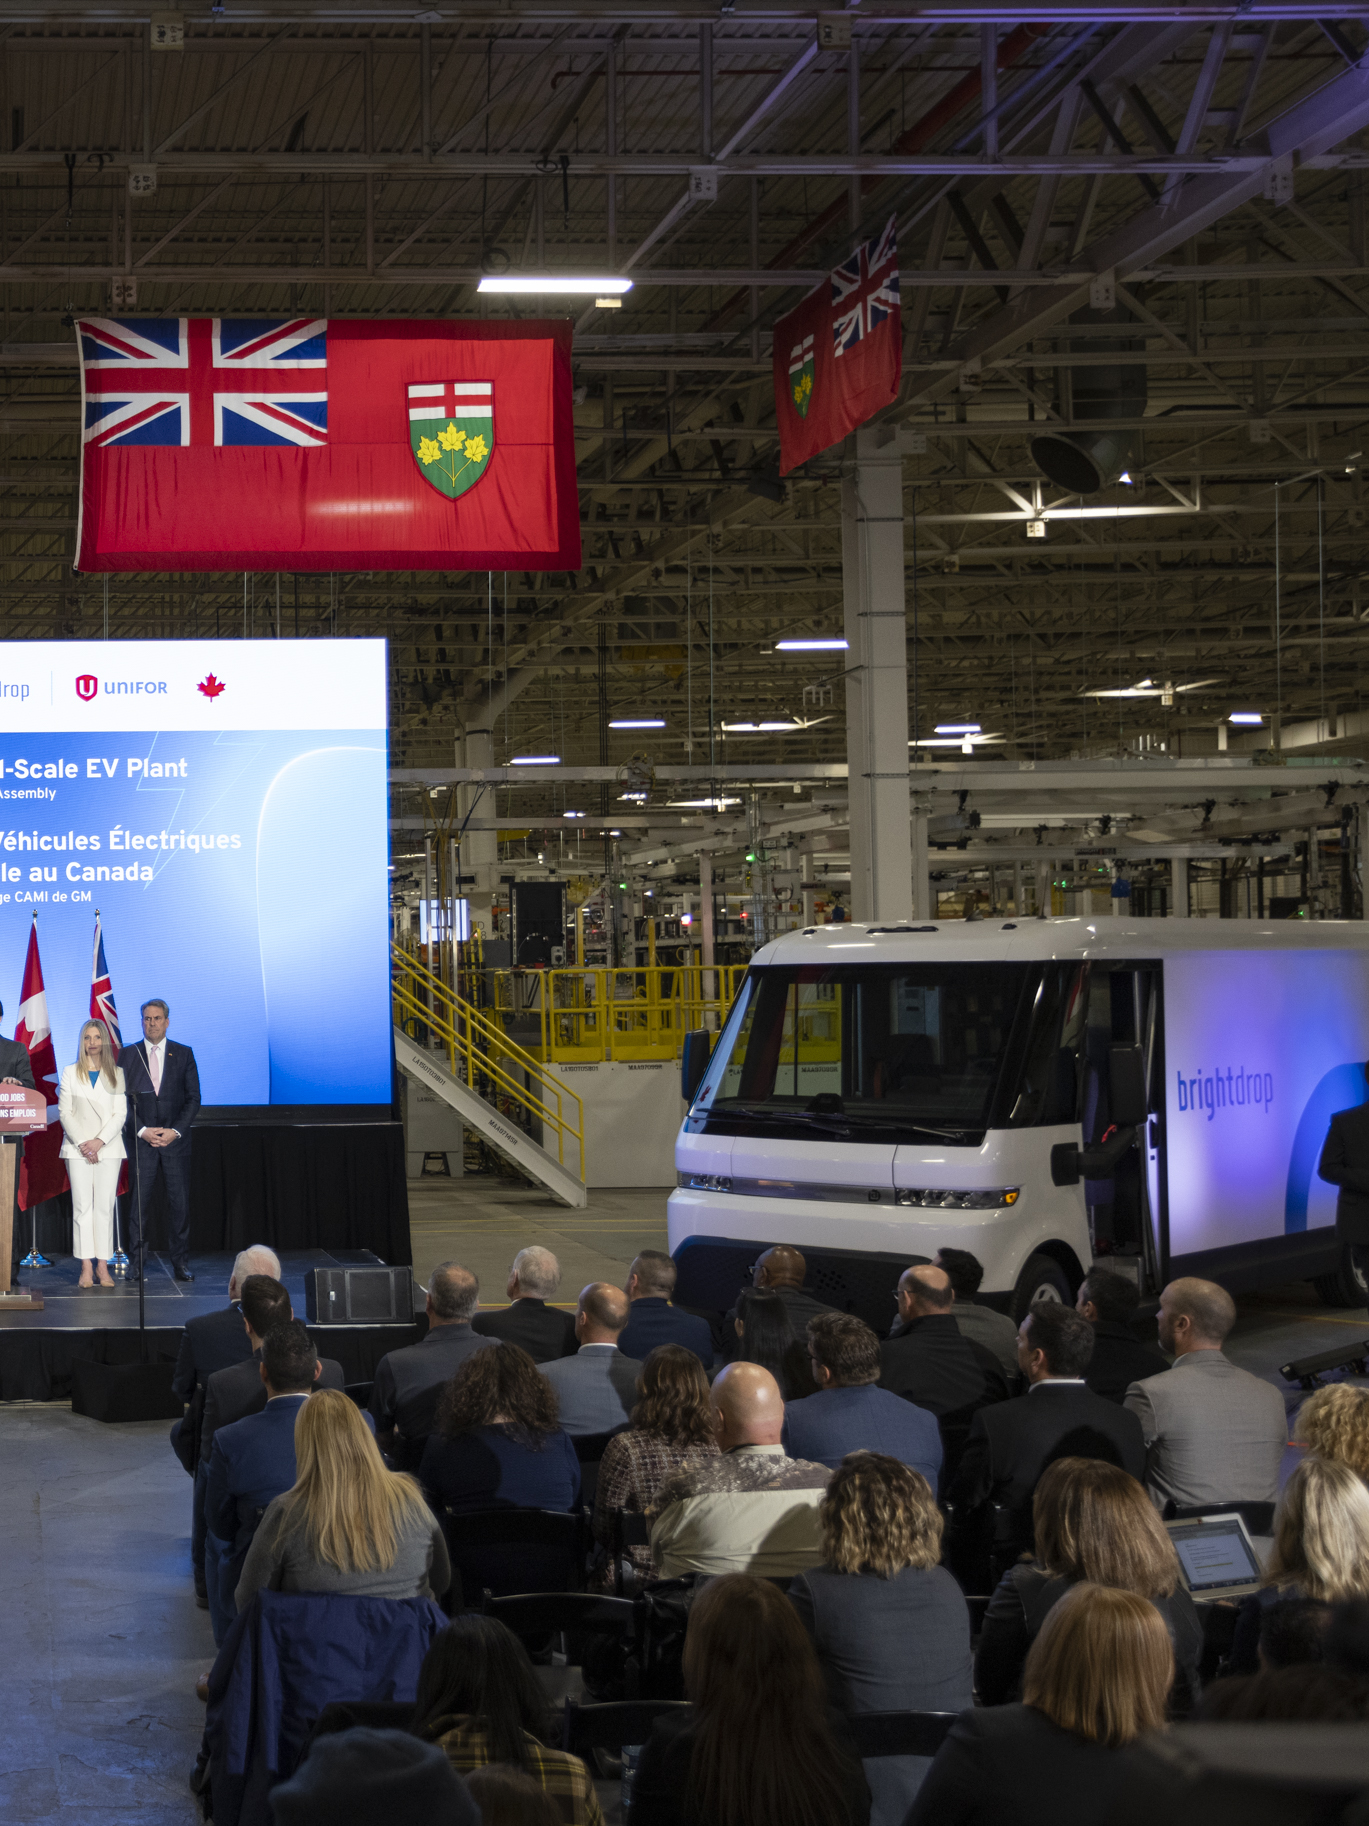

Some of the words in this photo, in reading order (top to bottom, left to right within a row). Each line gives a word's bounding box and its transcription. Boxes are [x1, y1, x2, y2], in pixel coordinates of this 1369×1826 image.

[87, 758, 119, 778] EV
[128, 758, 187, 777] Plant
[110, 825, 241, 853] Électriques
[29, 867, 57, 882] au
[66, 862, 153, 881] Canada
[15, 891, 48, 902] CAMI
[52, 891, 67, 902] de
[71, 891, 91, 902] GM
[9, 1094, 26, 1102] JOBS
[1177, 1065, 1273, 1121] brightdrop
[9, 1108, 37, 1118] EMPLOIS
